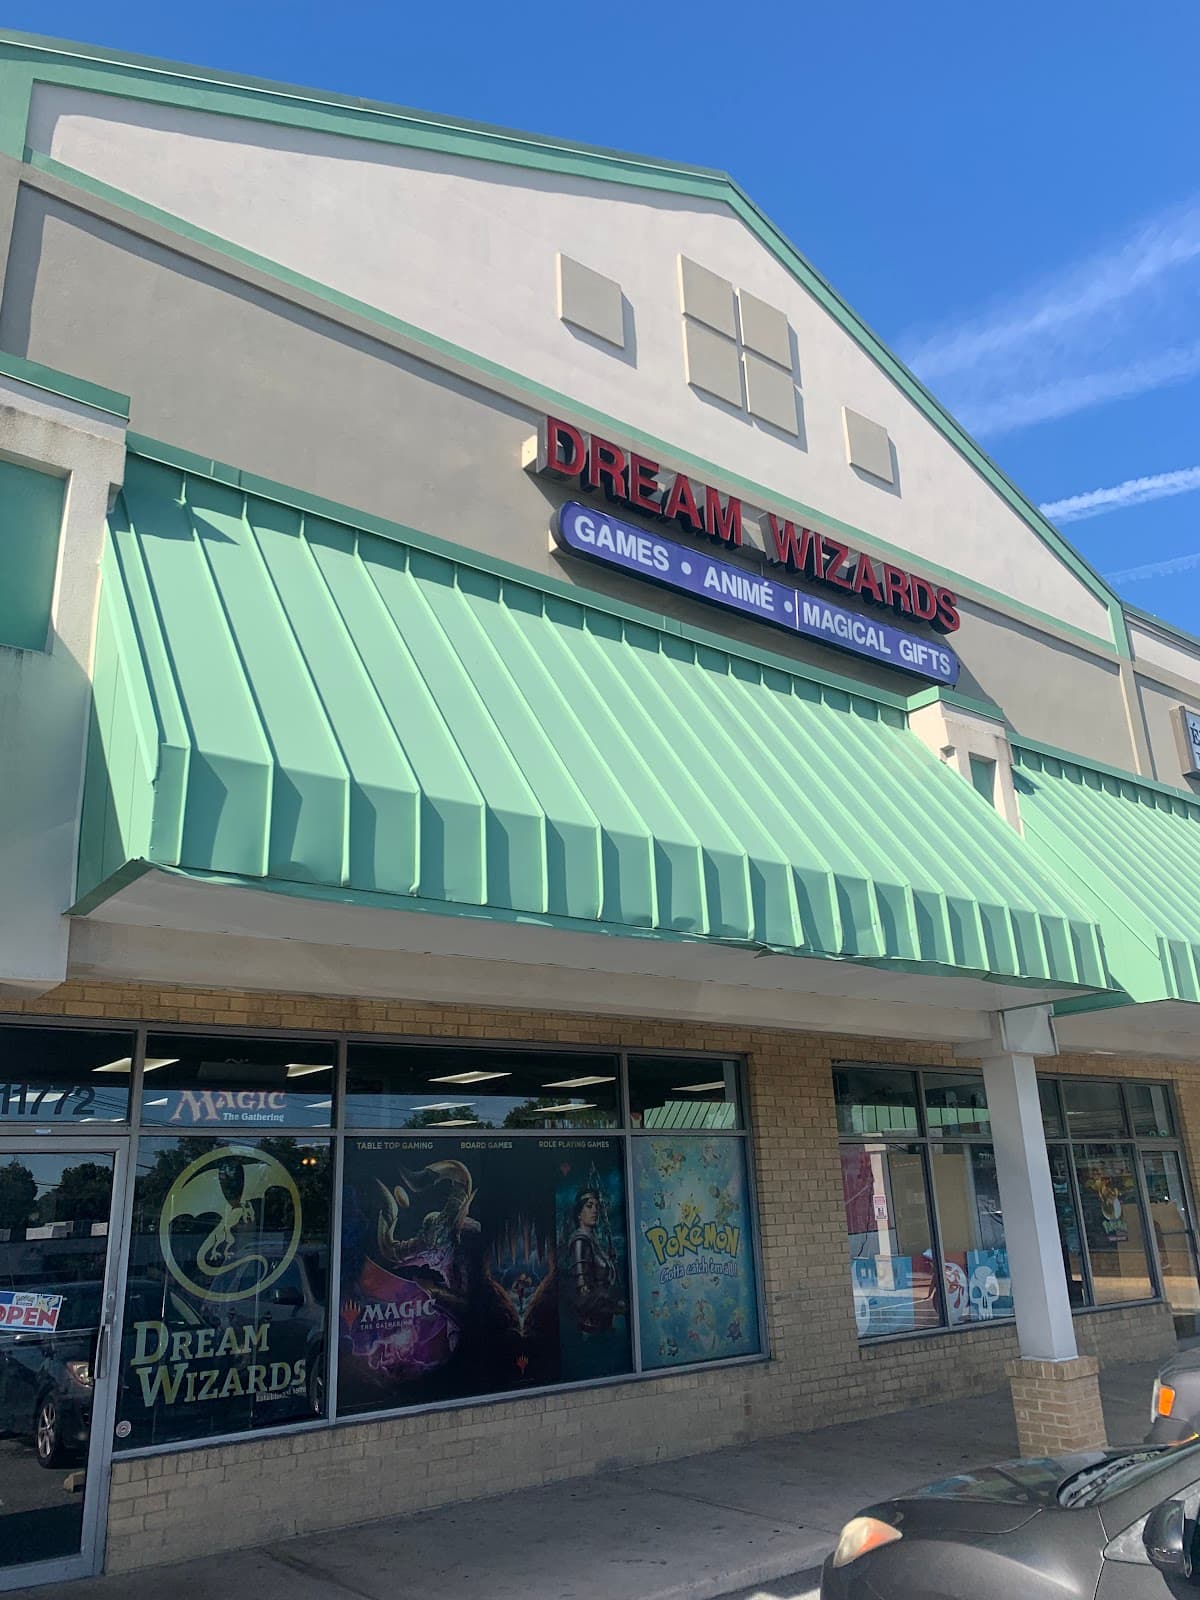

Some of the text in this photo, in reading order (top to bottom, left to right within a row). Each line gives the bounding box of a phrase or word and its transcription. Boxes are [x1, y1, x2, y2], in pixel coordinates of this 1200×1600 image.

[546, 415, 961, 632] DREAM WIZARDS
[573, 514, 952, 676] GAMES ANIMÉ MAGICAL GIFTS
[223, 1112, 285, 1122] The Gathering
[356, 1141, 434, 1150] TABLE TOP GAMING
[460, 1140, 513, 1149] BOARD GAMES
[538, 1140, 609, 1149] ROLE PLAYING GAMES
[360, 1298, 437, 1323] MAGIC
[130, 1321, 271, 1367] DREAM
[136, 1359, 306, 1408] WIZARDS
